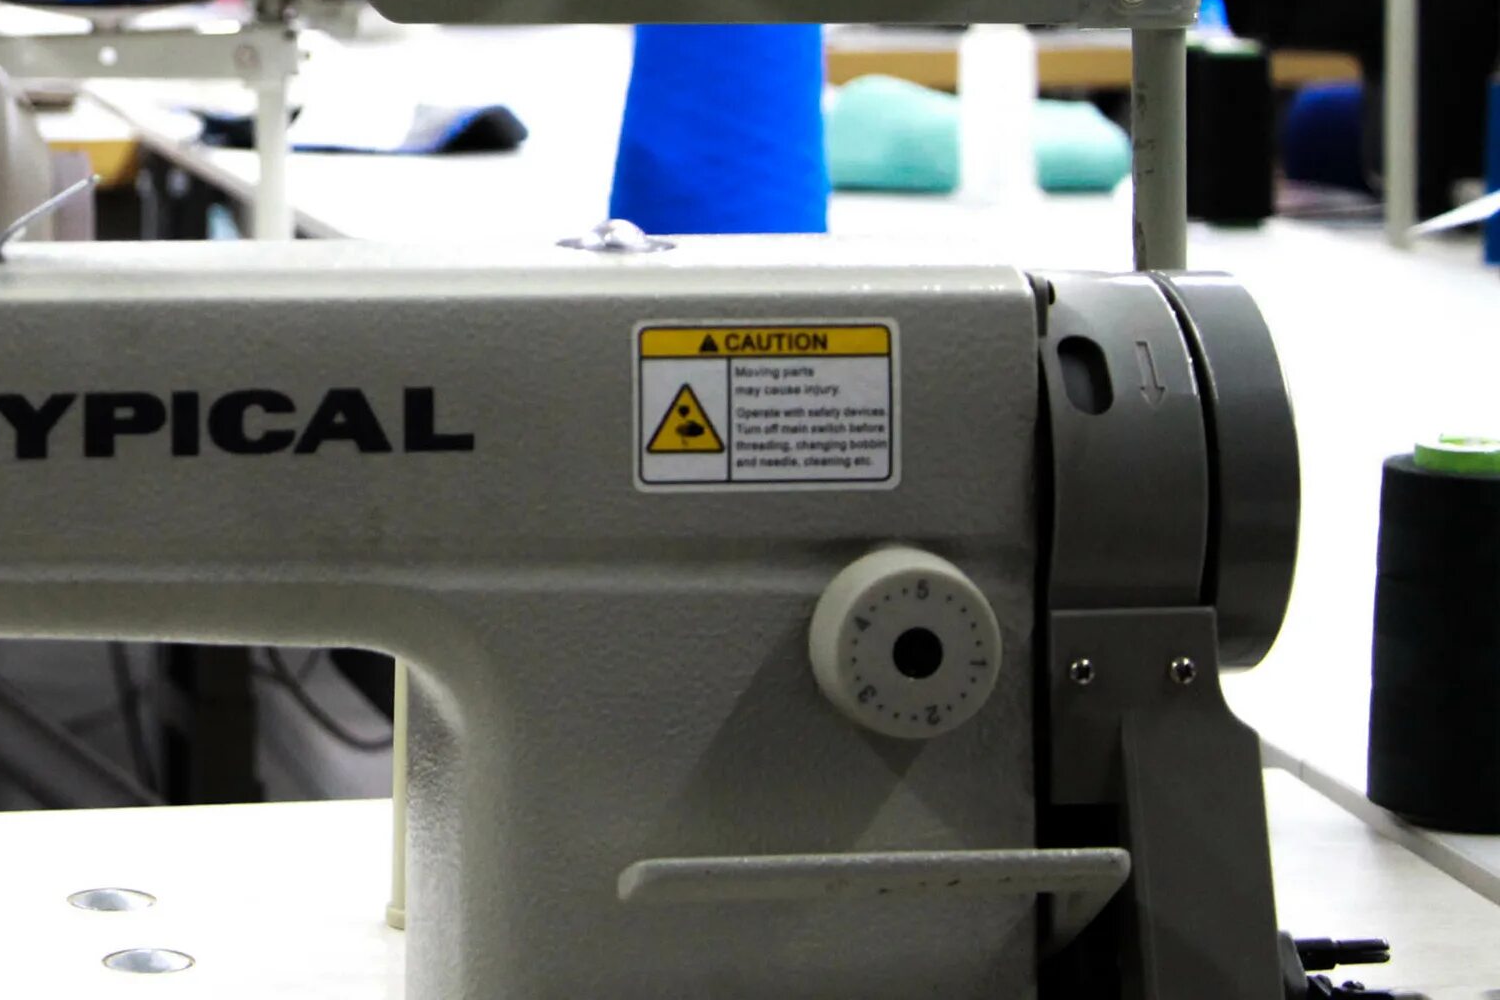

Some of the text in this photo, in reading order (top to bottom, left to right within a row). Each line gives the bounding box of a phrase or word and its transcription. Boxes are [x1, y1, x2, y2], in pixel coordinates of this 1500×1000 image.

[725, 333, 829, 352] CAUTION
[735, 366, 815, 380] Moving parts
[735, 384, 841, 397] may cause injury.
[736, 407, 780, 420] Operate
[784, 406, 805, 418] with
[808, 406, 840, 420] safety
[735, 422, 885, 434] Turn off main switch before
[795, 440, 847, 453] changing
[849, 439, 887, 450] bobbin
[736, 456, 757, 468] and
[803, 456, 851, 469] cleaning
[916, 579, 929, 600] 5
[854, 616, 871, 632] 4
[969, 658, 988, 668] 1
[858, 684, 877, 703] 3
[925, 704, 941, 726] 2
